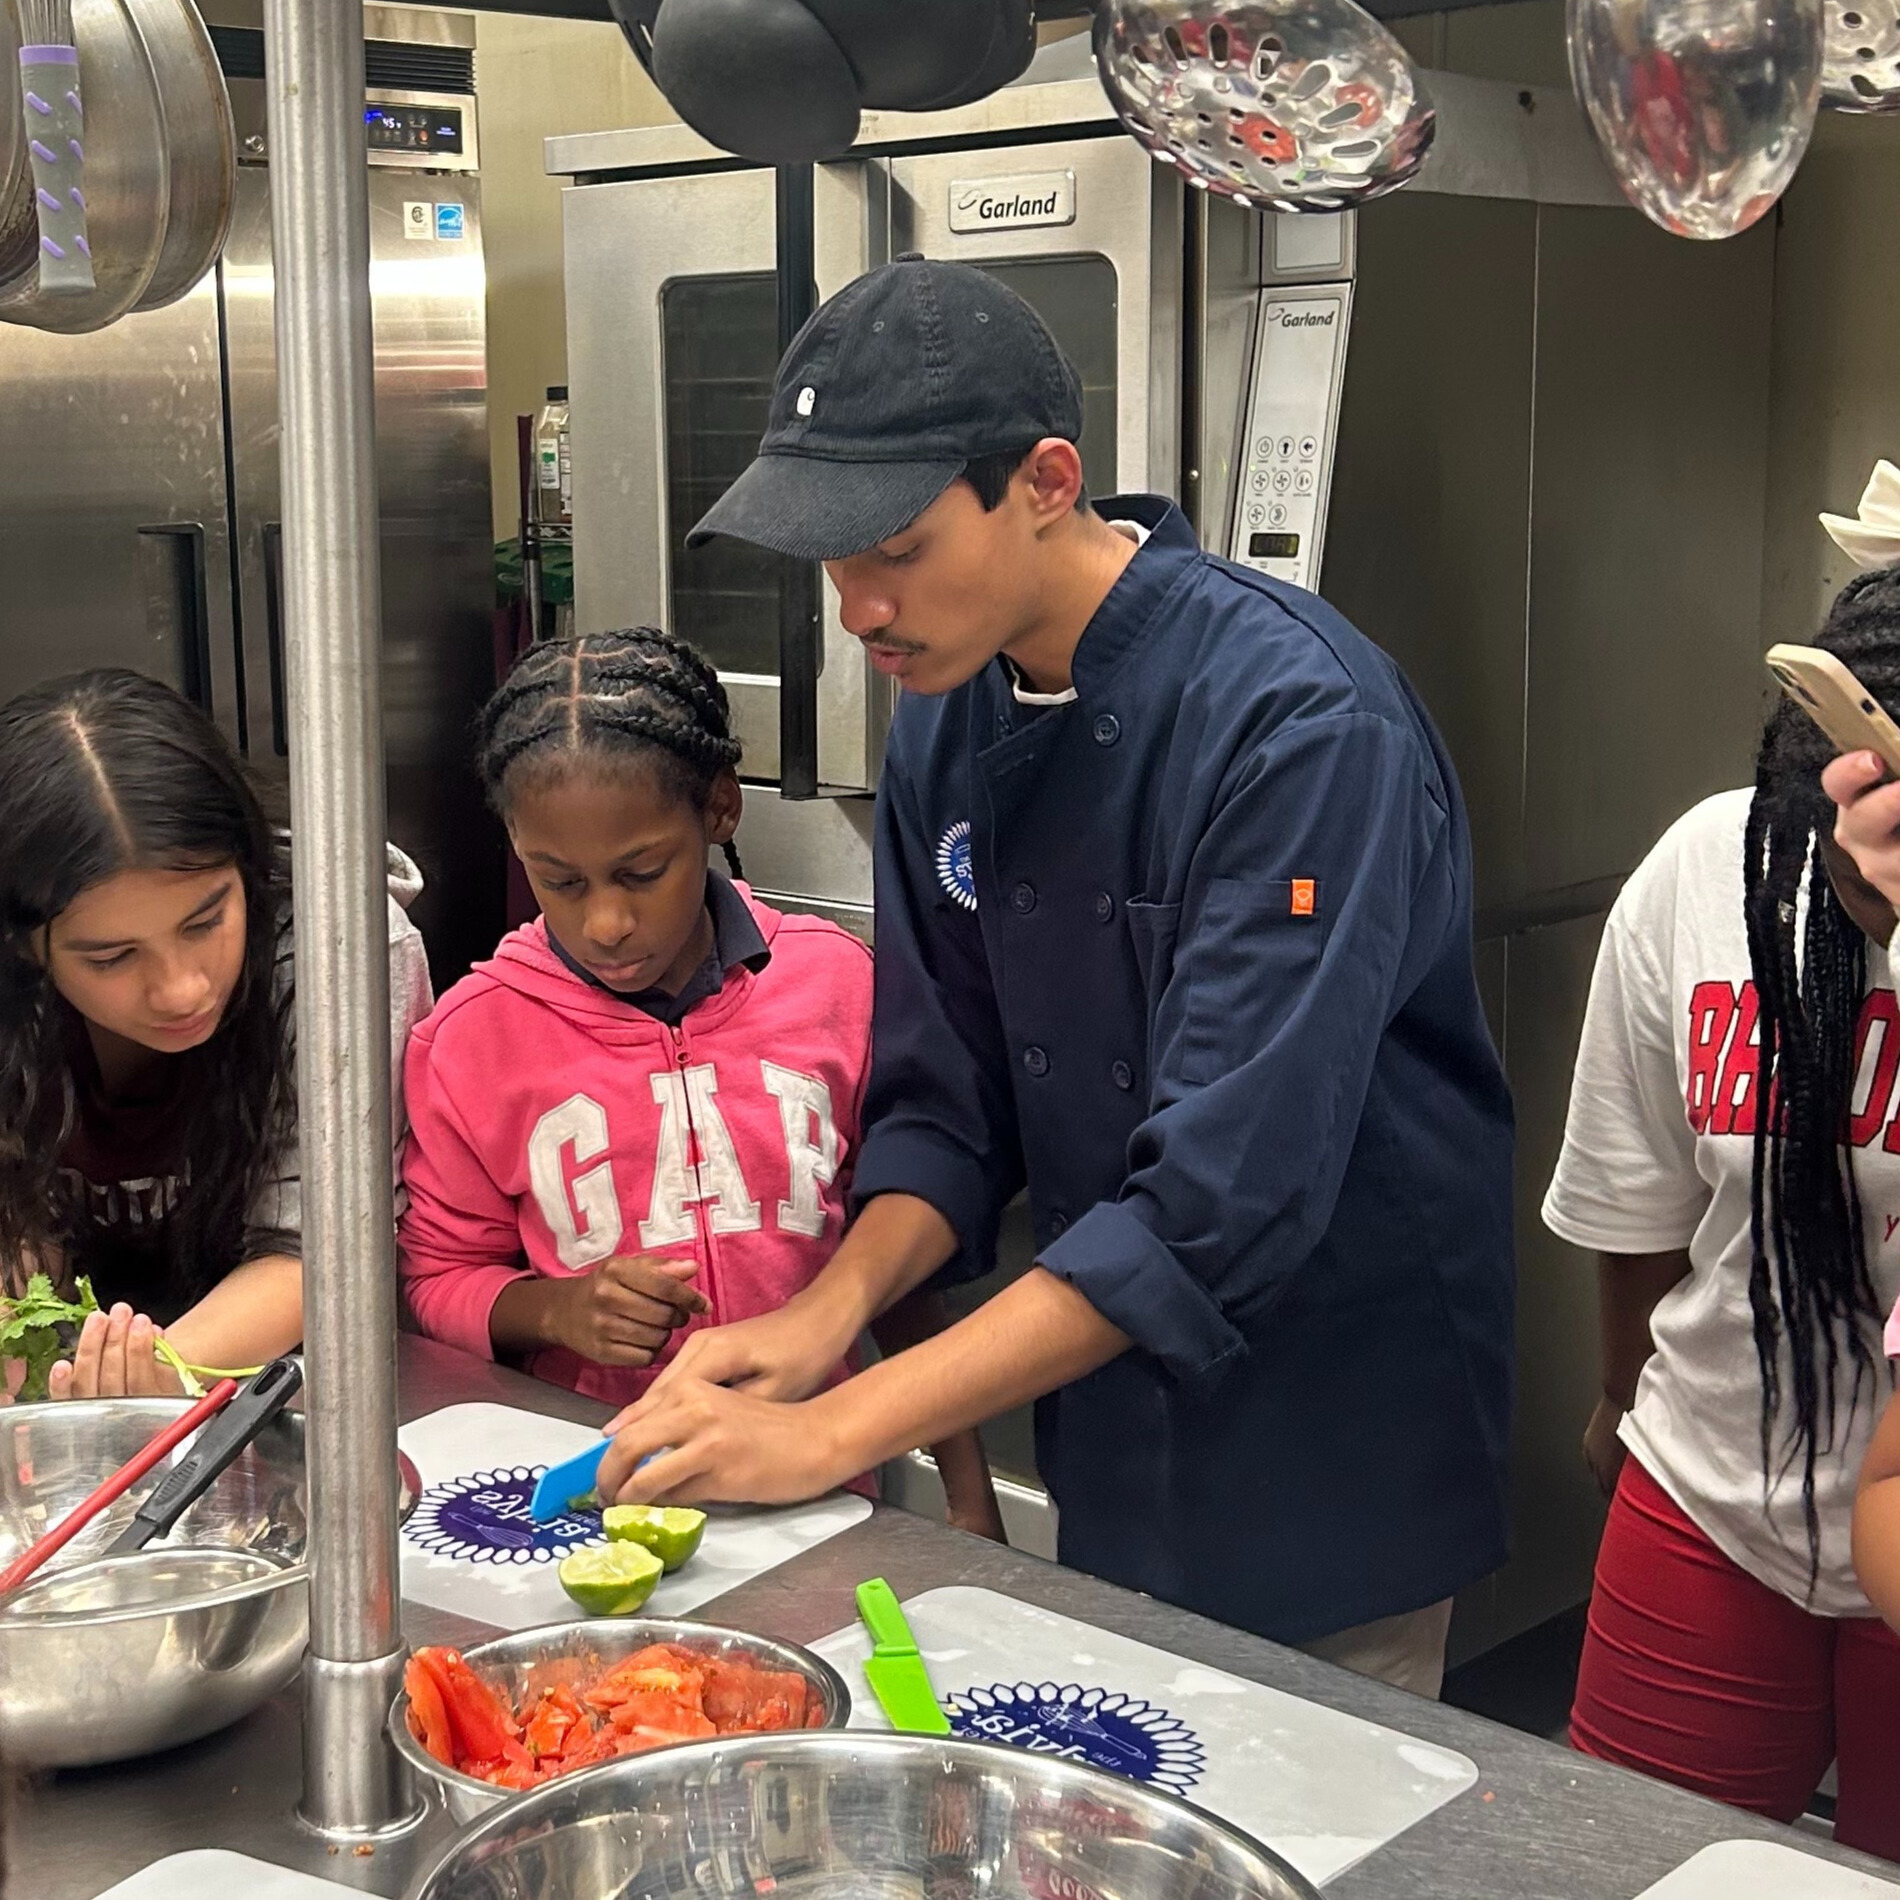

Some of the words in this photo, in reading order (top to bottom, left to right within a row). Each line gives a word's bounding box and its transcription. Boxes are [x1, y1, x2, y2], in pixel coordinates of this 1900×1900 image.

[979, 191, 1057, 219] Garland
[1281, 310, 1335, 328] Garland
[528, 1059, 838, 1271] GAP
